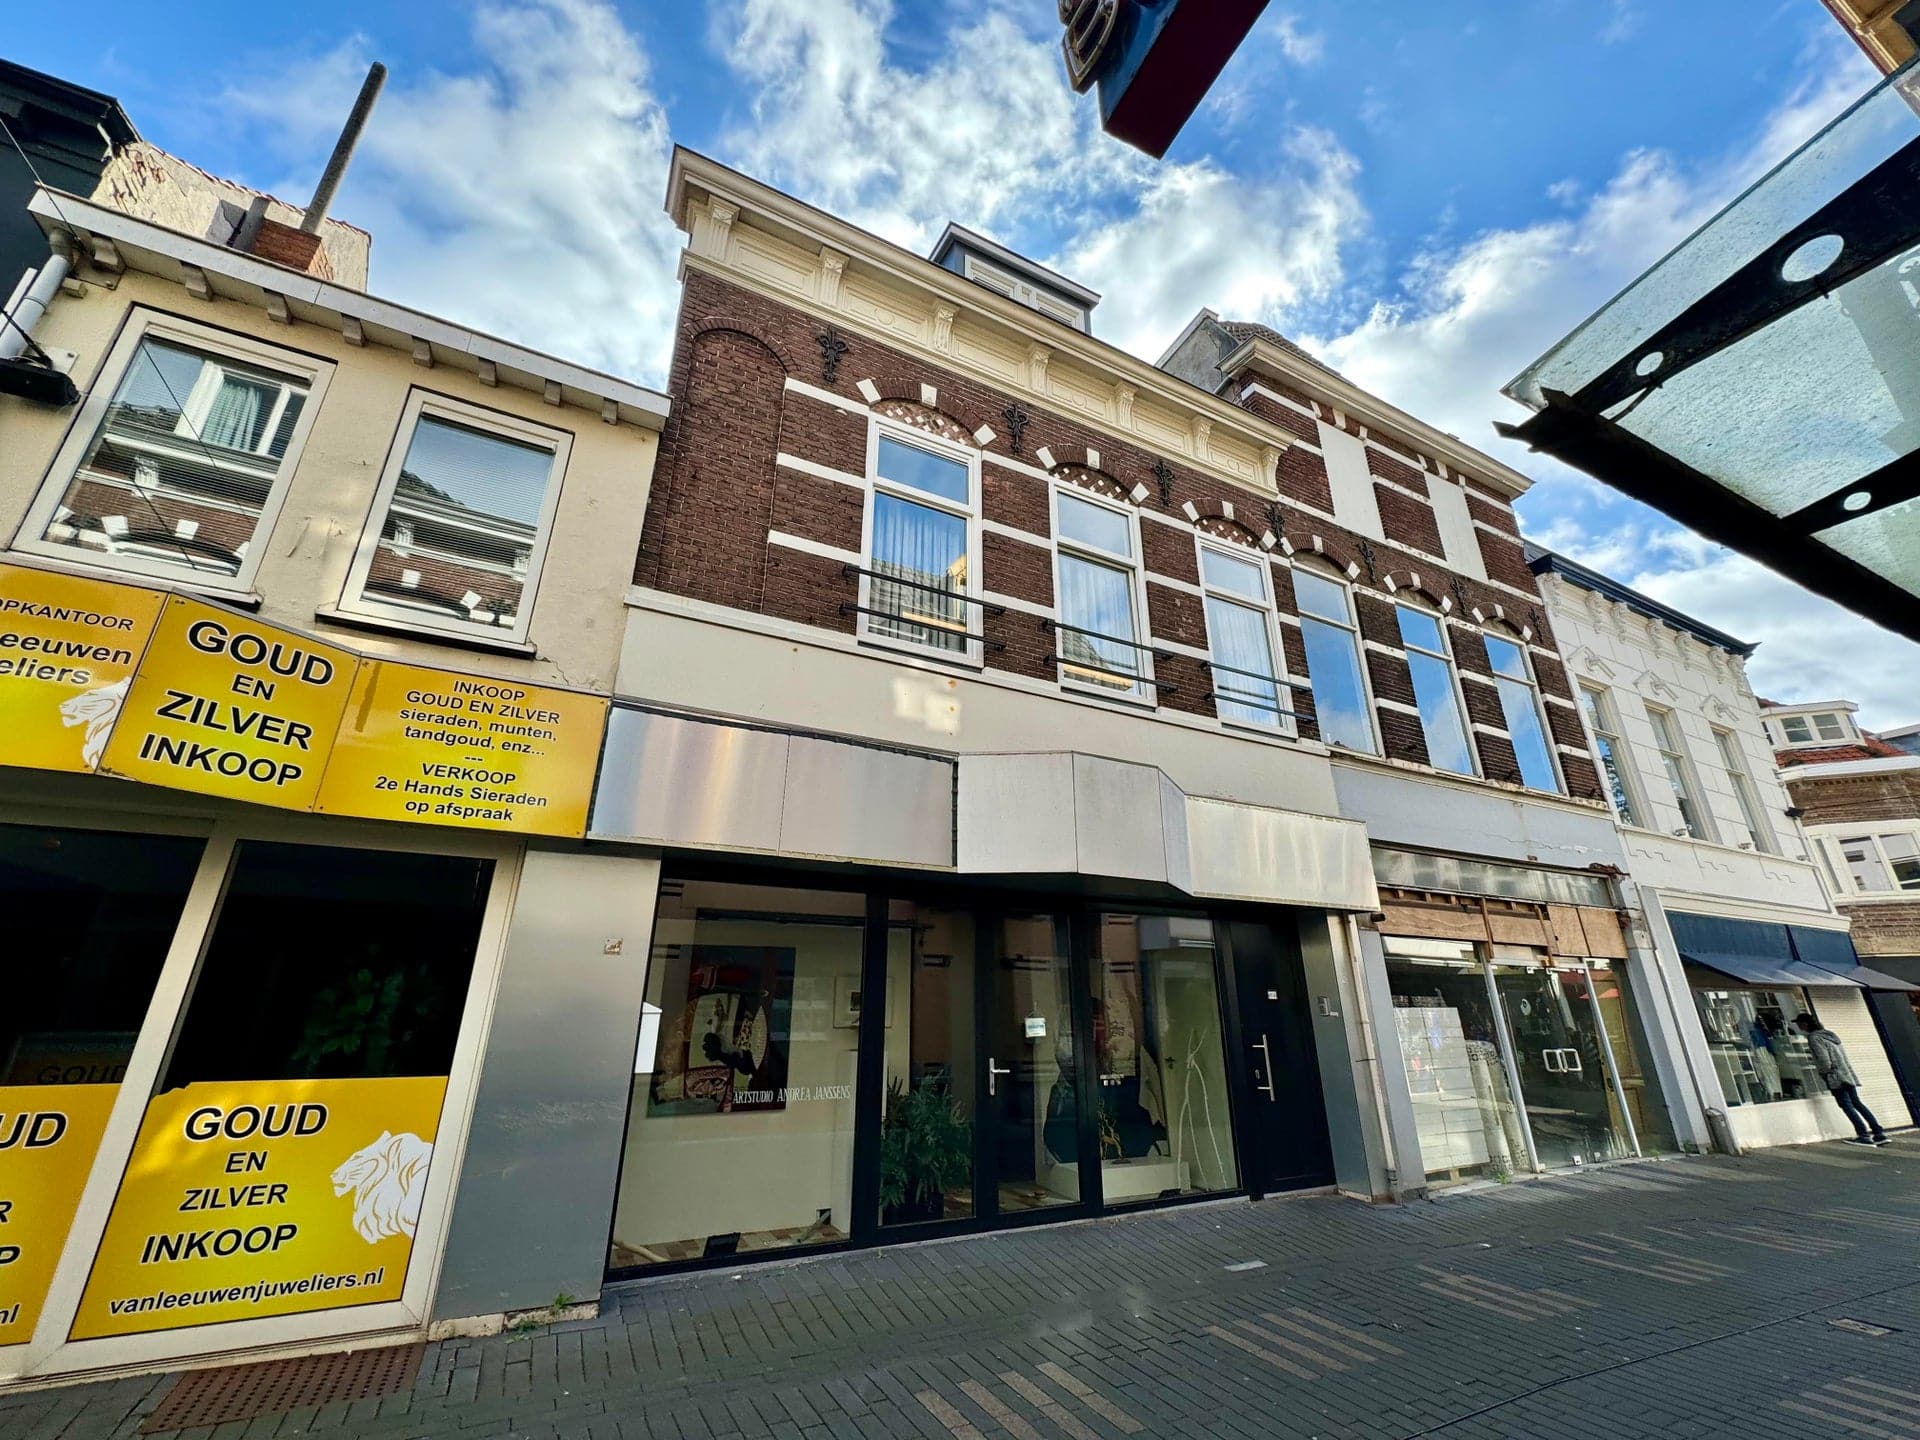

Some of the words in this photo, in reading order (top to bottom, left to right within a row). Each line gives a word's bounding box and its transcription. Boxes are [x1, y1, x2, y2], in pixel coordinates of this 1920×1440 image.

[0, 633, 132, 665] eeuwen
[188, 621, 333, 686] GOUD
[232, 674, 275, 701] EN
[453, 680, 525, 701] INKOOP
[157, 689, 312, 750] ZILVER
[406, 690, 463, 710] GOUD
[469, 700, 496, 714] EN
[499, 705, 560, 725] ZILVER
[400, 707, 482, 731] sieraden,
[489, 721, 557, 741] munten,
[405, 725, 495, 750] tandgoud,
[501, 740, 545, 755] enz...
[139, 733, 303, 786] INKOOP
[421, 763, 516, 786] VERKOOP
[374, 776, 398, 791] 2e
[404, 779, 464, 798] Hands
[470, 787, 547, 808] Sieraden
[405, 800, 429, 815] op
[435, 803, 513, 821] afspraak
[733, 1090, 774, 1104] ARTSTUDIO
[777, 1087, 811, 1102] ANDREA
[813, 1085, 851, 1100] JANSSENS
[185, 1103, 328, 1143] GOUD
[225, 1151, 268, 1174] EN
[179, 1183, 289, 1212] ZILVER
[141, 1223, 298, 1264] INKOOP
[110, 1268, 385, 1315] vanleeuwenjuweliers.nl
